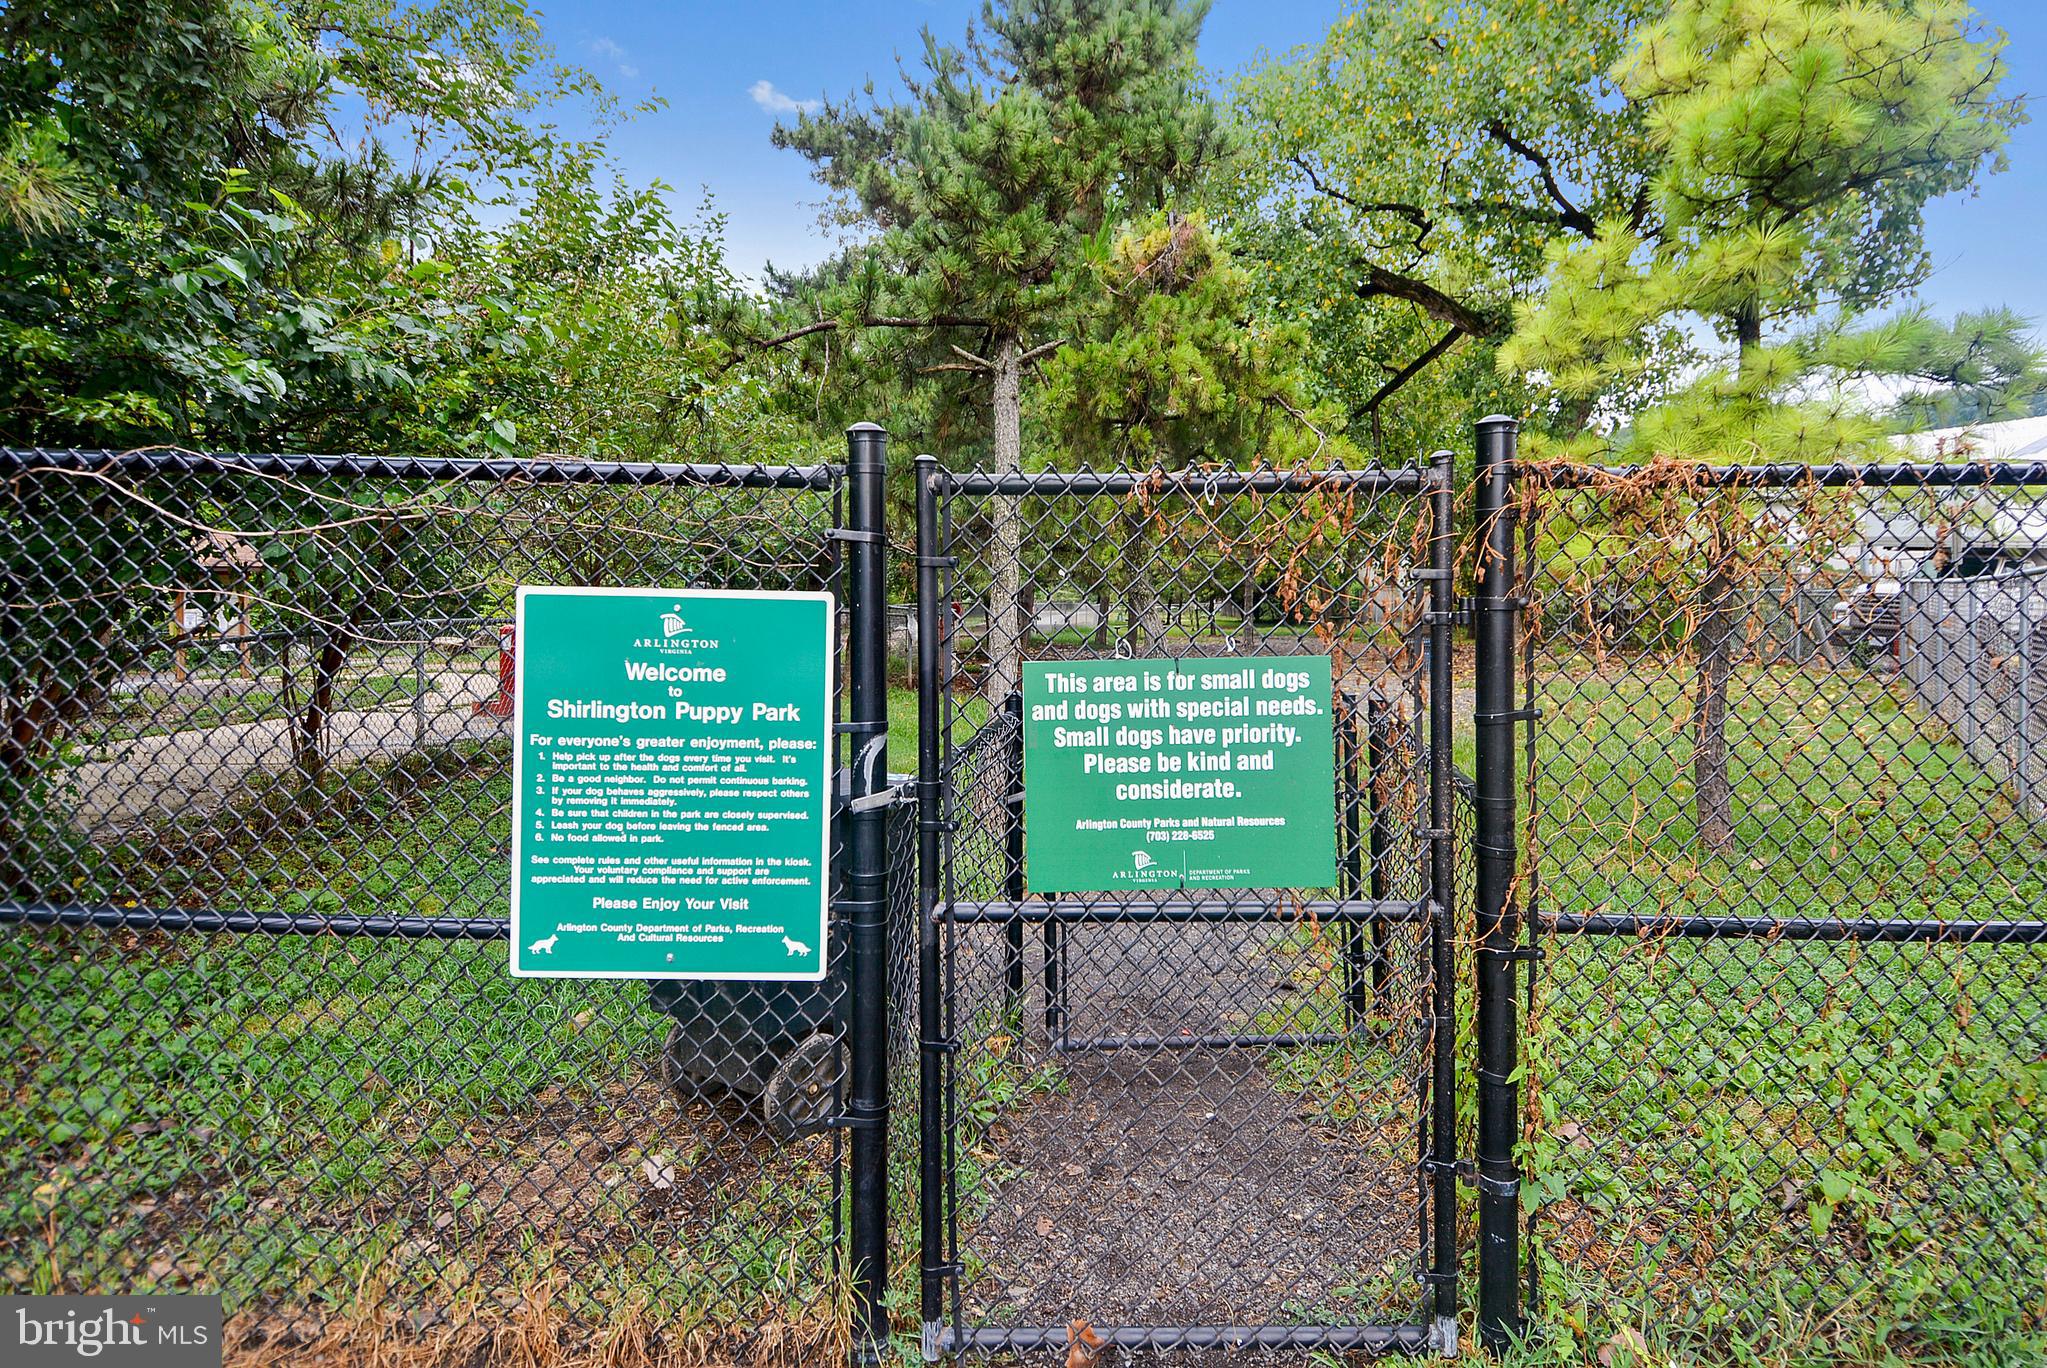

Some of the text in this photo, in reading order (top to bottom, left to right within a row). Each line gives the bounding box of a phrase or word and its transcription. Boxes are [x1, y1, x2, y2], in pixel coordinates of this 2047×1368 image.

[633, 638, 718, 649] ARLINGTON
[624, 662, 726, 682] Welcome
[1044, 668, 1310, 693] This area is for small dogs
[667, 685, 683, 697] to
[546, 698, 800, 724] Shirlington Puppy Park
[1031, 694, 1323, 723] and dogs with special needs.
[529, 733, 817, 751] For everyone's greater enjoyment, please:
[1053, 722, 1301, 749] Small dogs have priority.
[538, 751, 796, 764] 1. Help pick up after the dogs every time you visit. It's
[1083, 749, 1274, 774] Please be kind and
[551, 761, 747, 772] important to the health and comfort of all.
[535, 773, 808, 787] 2. Be a good neighbor. Do not permit continuous barking.
[535, 785, 810, 798] 3. If your dog behaves aggressively, please respect others
[1115, 778, 1242, 800] considerate.
[551, 794, 677, 807] by removing it immediately.
[534, 807, 809, 820] 4. Be sure that children in the park are closely supervised.
[535, 820, 544, 829] 5.
[550, 820, 579, 829] Leash
[581, 822, 602, 831] your
[604, 821, 624, 832] dog
[625, 821, 656, 830] before
[658, 821, 691, 832] leaving
[693, 822, 709, 831] the
[711, 822, 744, 831] fenced
[1075, 815, 1285, 831] Arlington County Parks and Natural Resources
[534, 832, 664, 844] 6. No food allowed in park.
[1145, 829, 1215, 843] (703) 228-6525
[530, 854, 812, 866] See complete rules and other useful information in the kiosk.
[571, 863, 770, 876] Your voluntary compliance and support are
[1112, 869, 1177, 878] ARLINGTON
[530, 873, 811, 885] appreciated and will reduce the need for active enforcement.
[592, 896, 749, 911] Please Enjoy Your Visit
[556, 922, 784, 934] Arlington County Department of Parks, Recreation
[616, 932, 724, 942] And Cultural Resources
